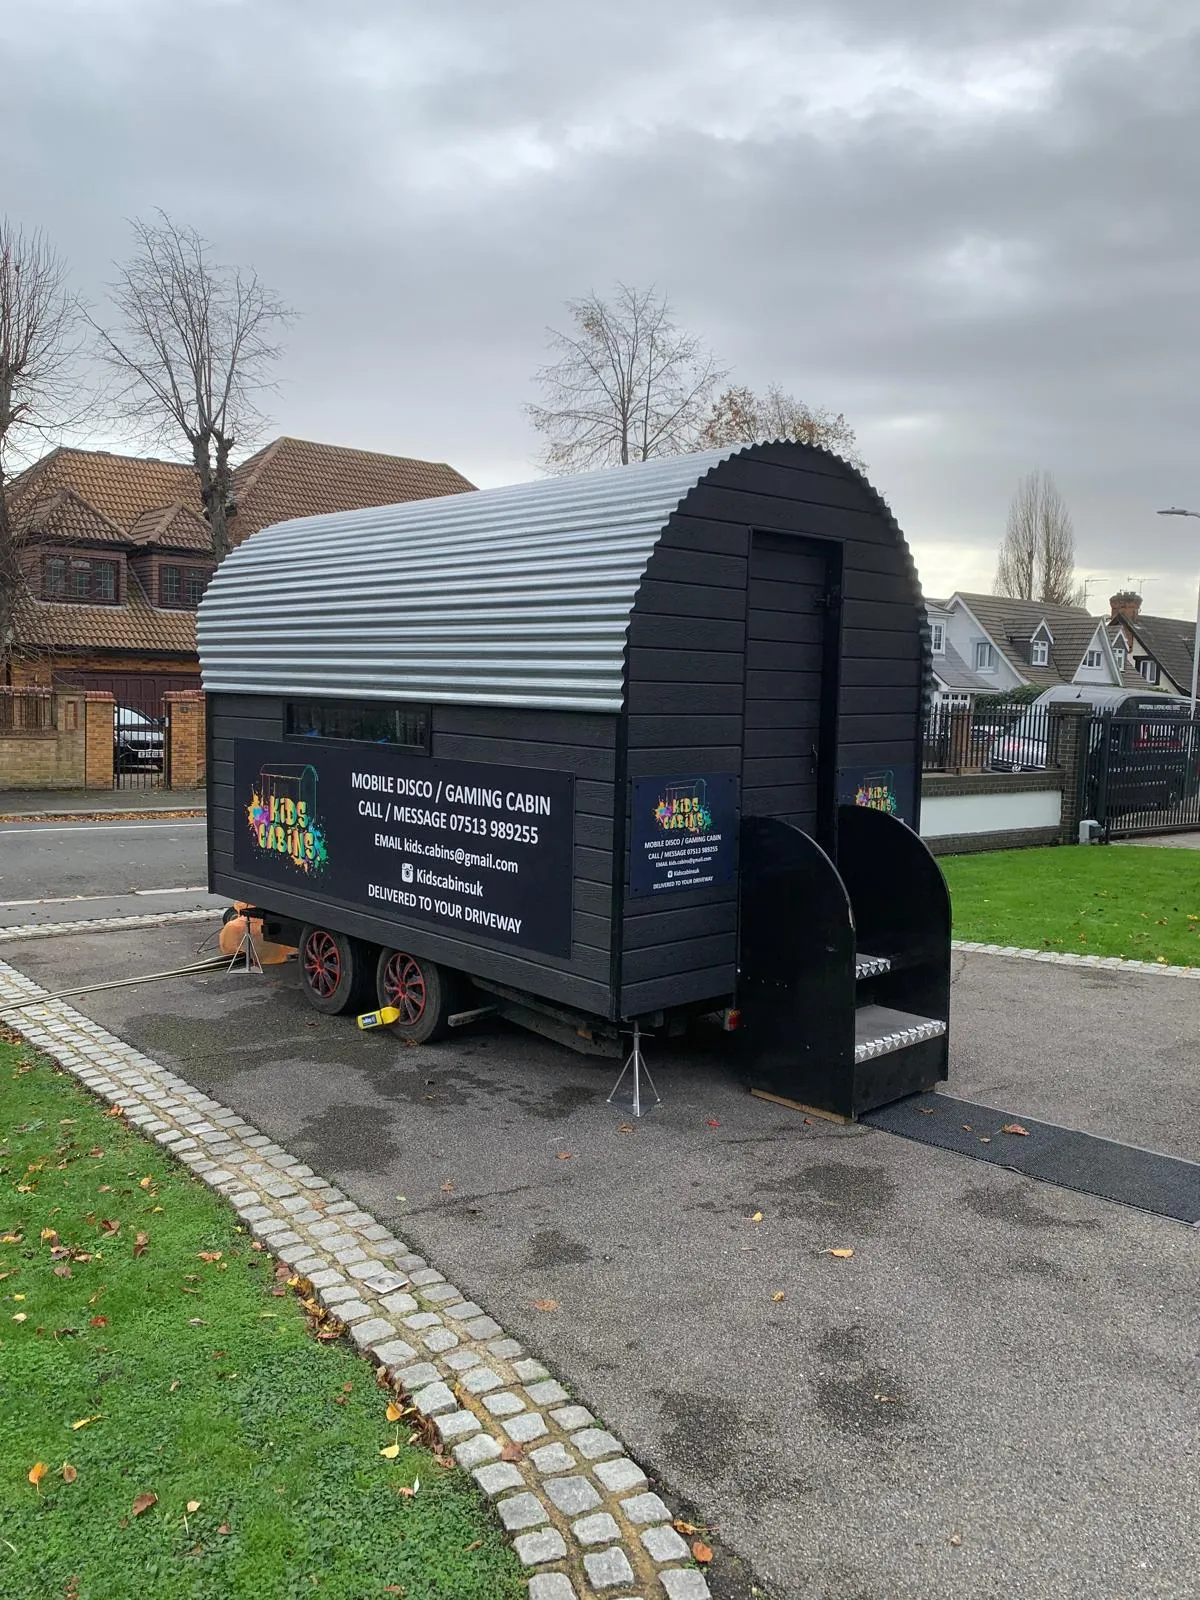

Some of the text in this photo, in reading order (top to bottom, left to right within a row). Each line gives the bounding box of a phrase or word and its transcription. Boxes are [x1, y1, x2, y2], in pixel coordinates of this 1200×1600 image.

[351, 772, 551, 816] MOBILE DISCO / GAMING CABIN
[358, 800, 539, 844] CALL / MESSAGE 07513 989255
[644, 840, 665, 848] MOBILE
[665, 838, 681, 847] DISCO
[685, 836, 706, 844] GAMING
[706, 834, 722, 842] CABIN
[374, 833, 519, 873] EMAIL kids.cabins@gmail.com
[648, 852, 660, 860] CALL
[664, 849, 686, 858] MESSAGE
[687, 847, 701, 855] 07513
[416, 868, 484, 897] Kidscabinsuk
[368, 883, 522, 934] DELIVERED TO YOUR DRIVEWAY
